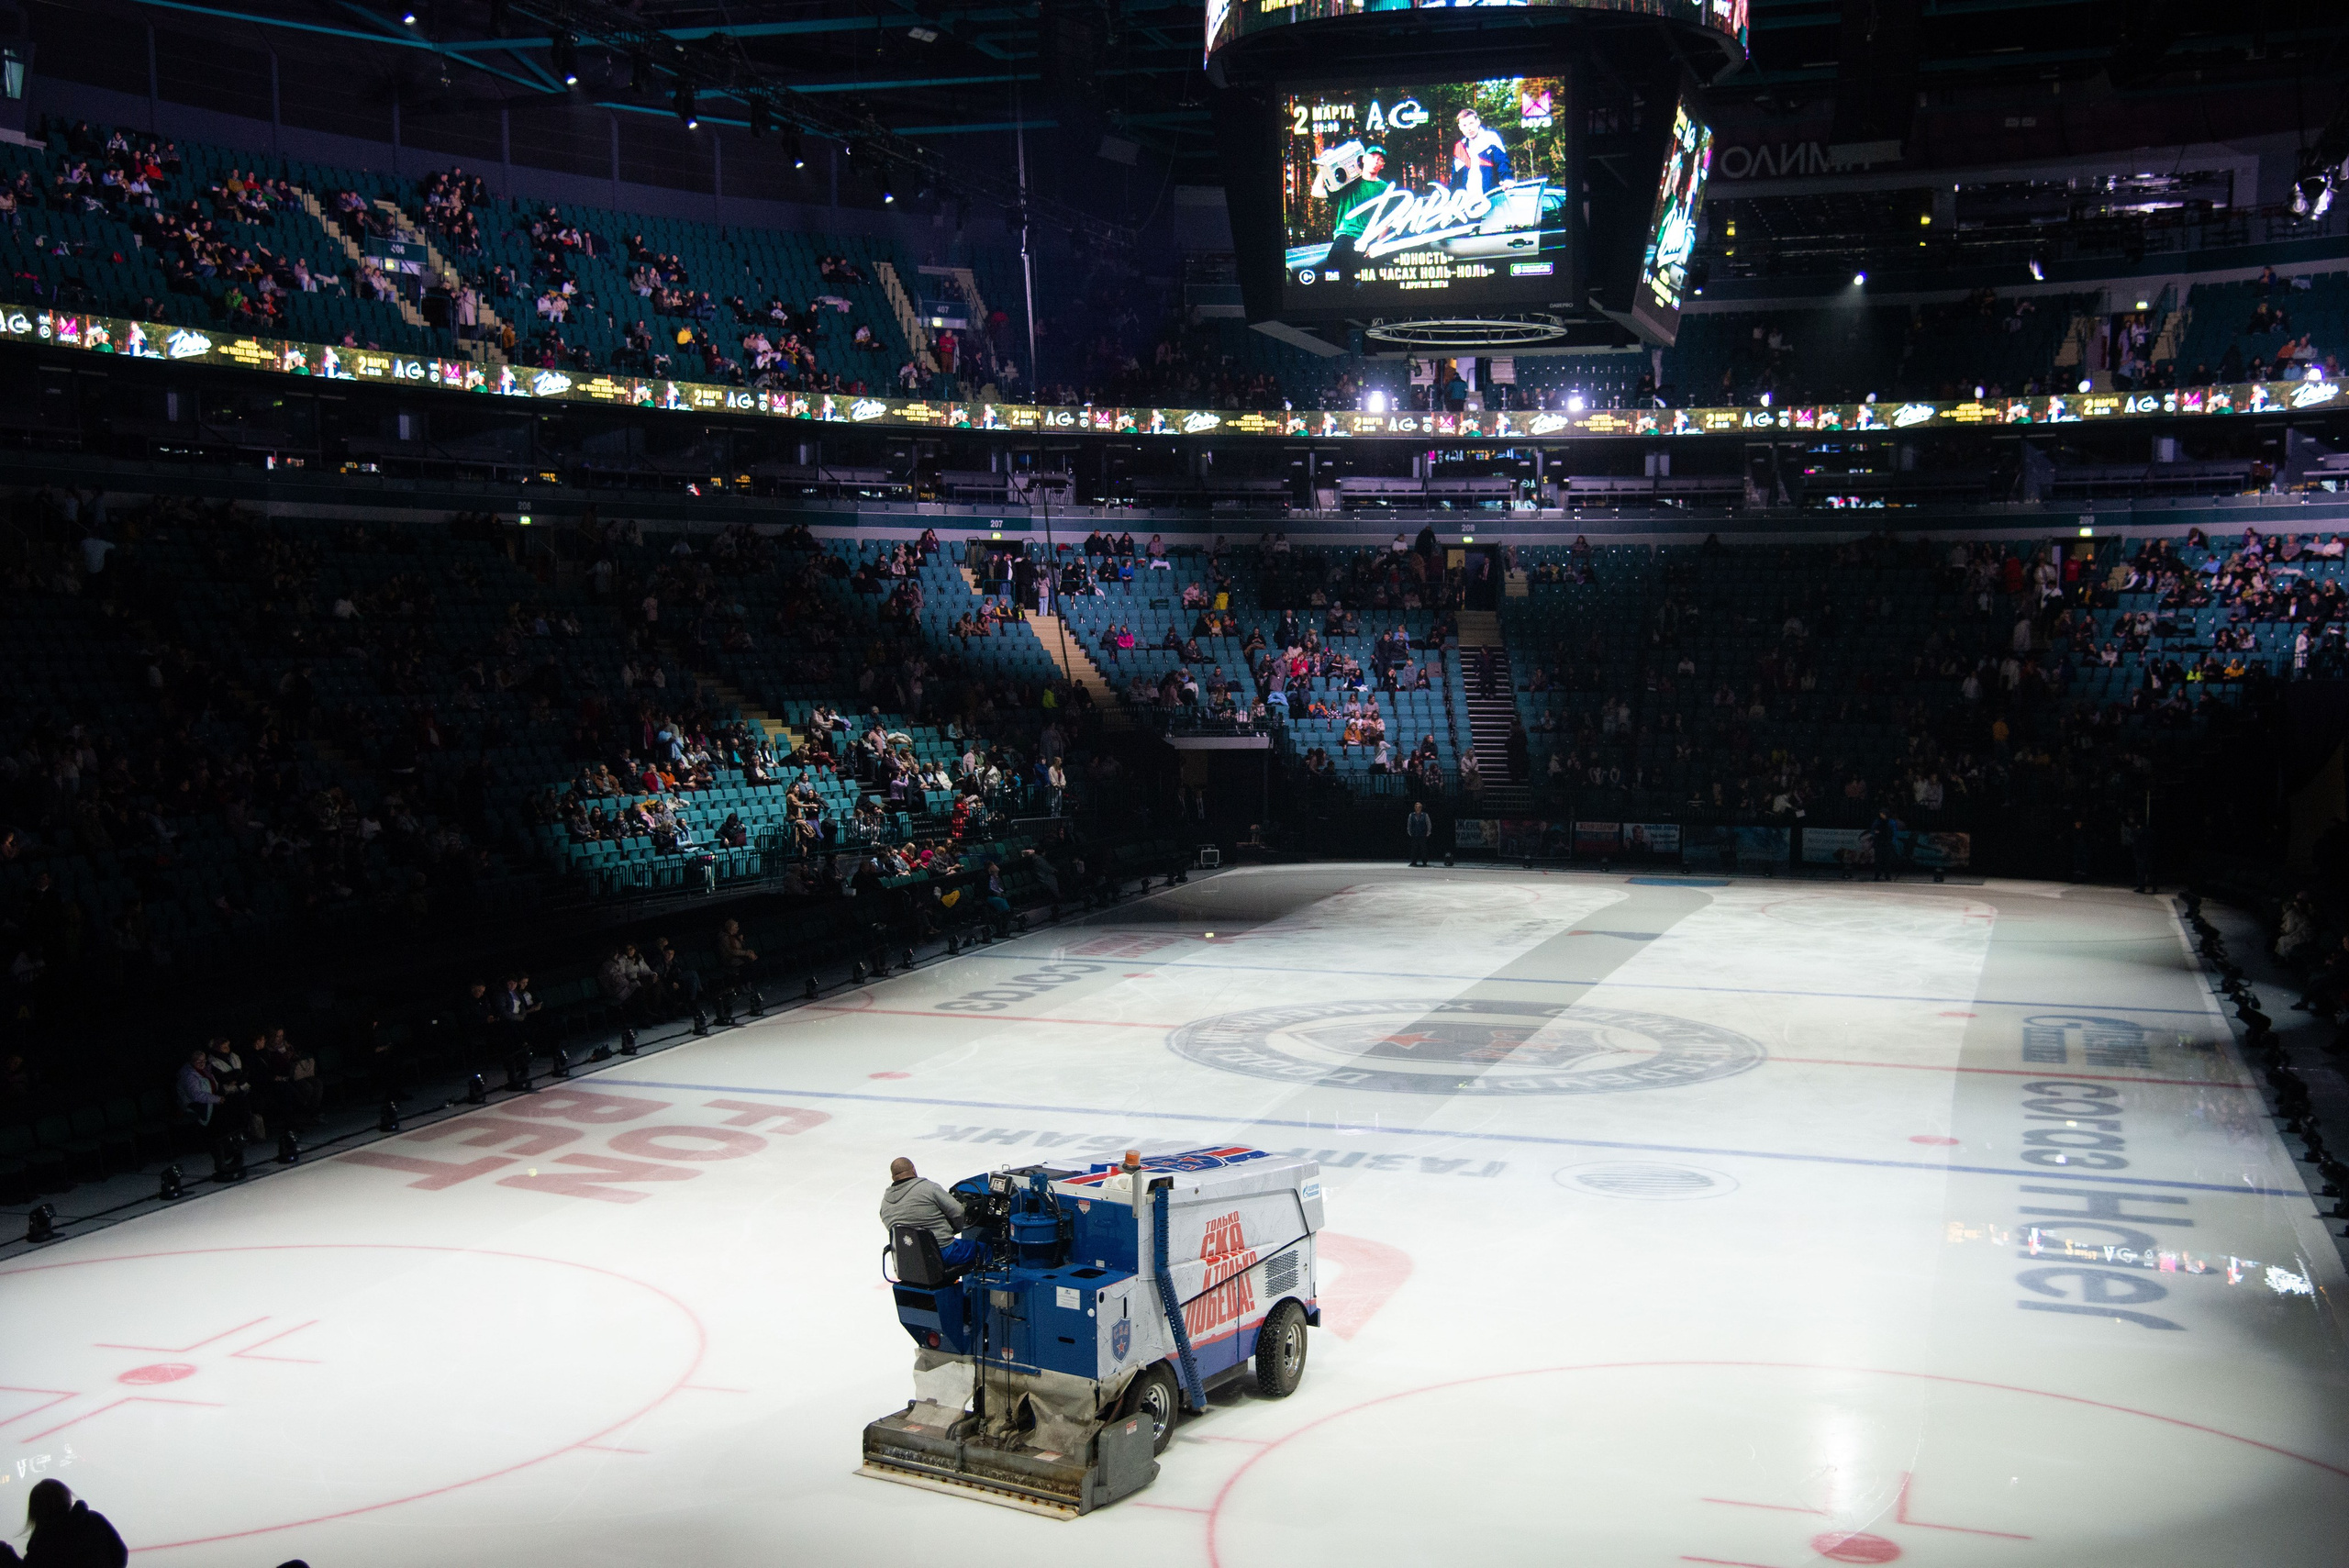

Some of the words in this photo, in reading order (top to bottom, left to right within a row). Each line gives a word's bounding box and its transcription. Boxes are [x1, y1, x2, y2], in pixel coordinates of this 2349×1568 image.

[1293, 106, 1308, 135] 2
[1312, 105, 1355, 121] МАРТА
[1312, 122, 1341, 134] 20:00
[1393, 251, 1454, 266] «ЮНОСТЬ»
[1354, 268, 1376, 282] «НА
[1379, 267, 1418, 281] ЧАСАХ
[1420, 264, 1495, 280] НОЛЬ-НОЛЬ»
[358, 356, 367, 374] 2
[695, 389, 702, 406] 2
[2084, 399, 2093, 415] 2
[1012, 410, 1019, 426] 2
[1353, 417, 1362, 431] 2
[1706, 413, 1714, 428] 2
[990, 519, 1003, 528] 207
[1461, 524, 1475, 532] 208
[1205, 1210, 1240, 1233] ТОЛЬКО
[1199, 1222, 1252, 1266] СКА
[1203, 1267, 1212, 1293] И
[1214, 1251, 1257, 1284] ТОЛЬКО
[1185, 1273, 1256, 1339] ПОБЕДА!
[1113, 1324, 1130, 1340] СКА
